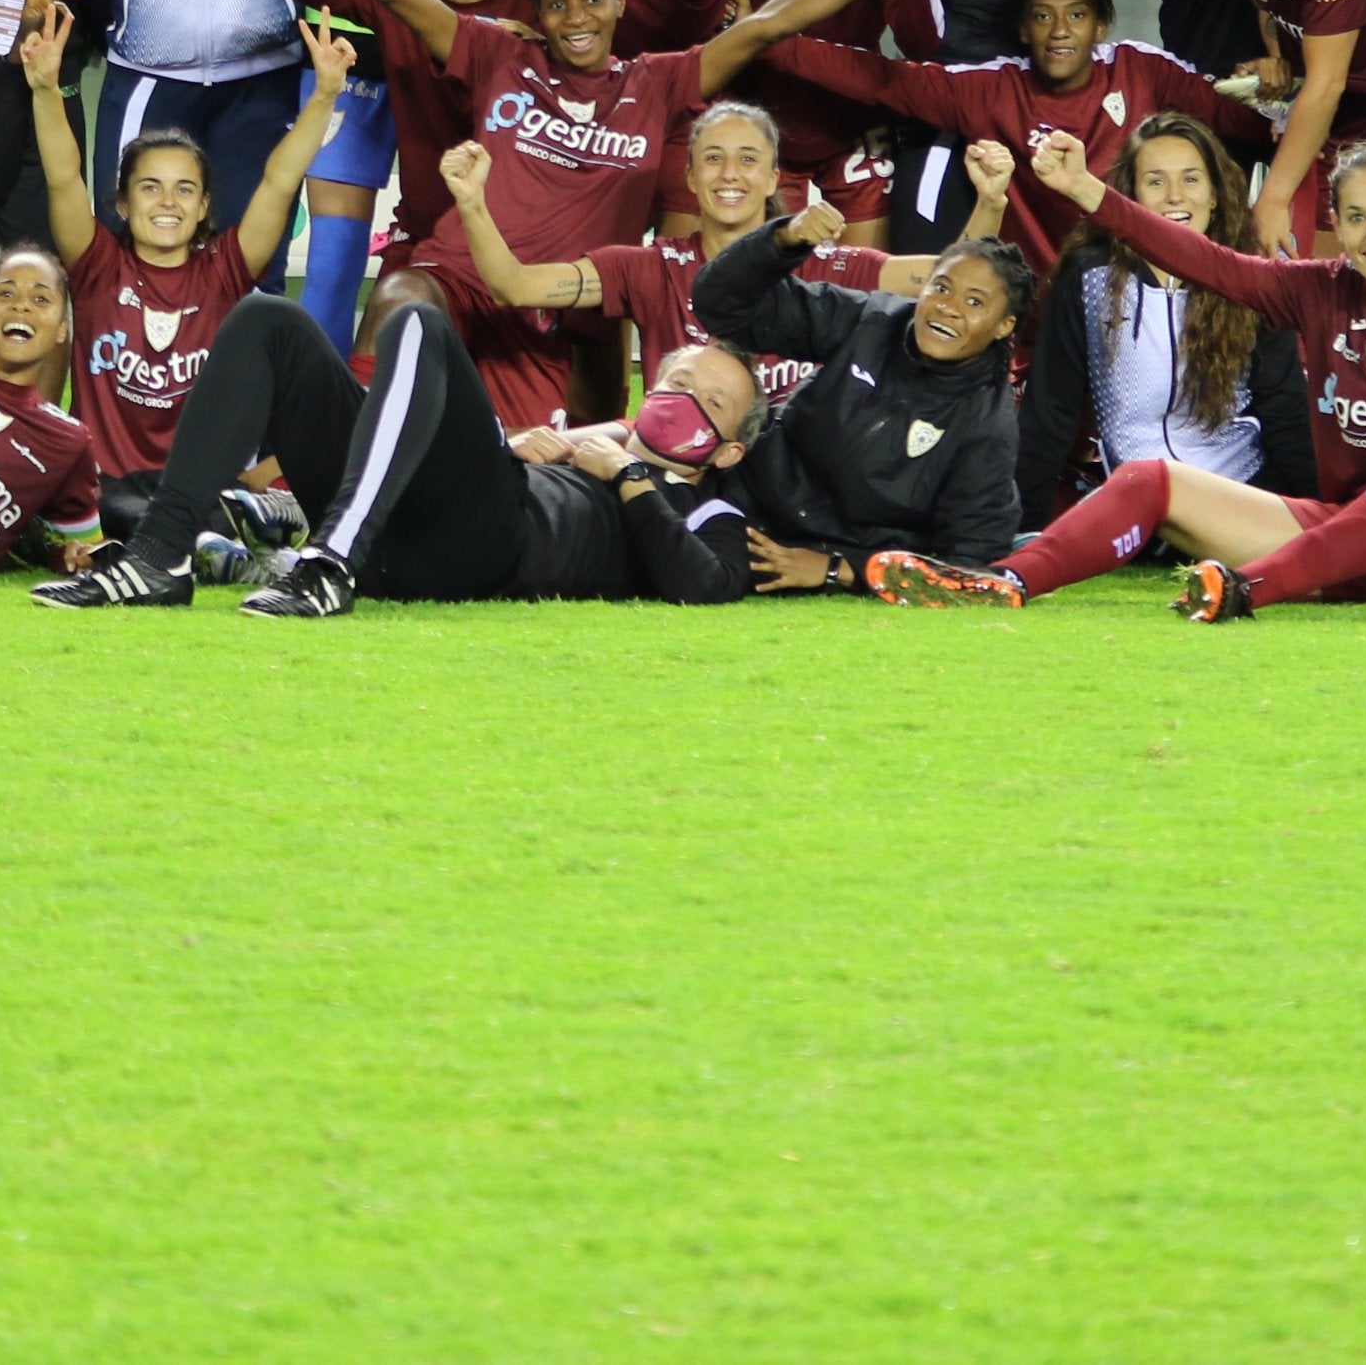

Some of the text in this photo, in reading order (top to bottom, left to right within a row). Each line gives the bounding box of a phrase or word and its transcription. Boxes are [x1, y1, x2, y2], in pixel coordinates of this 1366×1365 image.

[517, 108, 648, 158] gesitma
[515, 141, 579, 170] FERALCO GROUP
[116, 348, 210, 390] gestm
